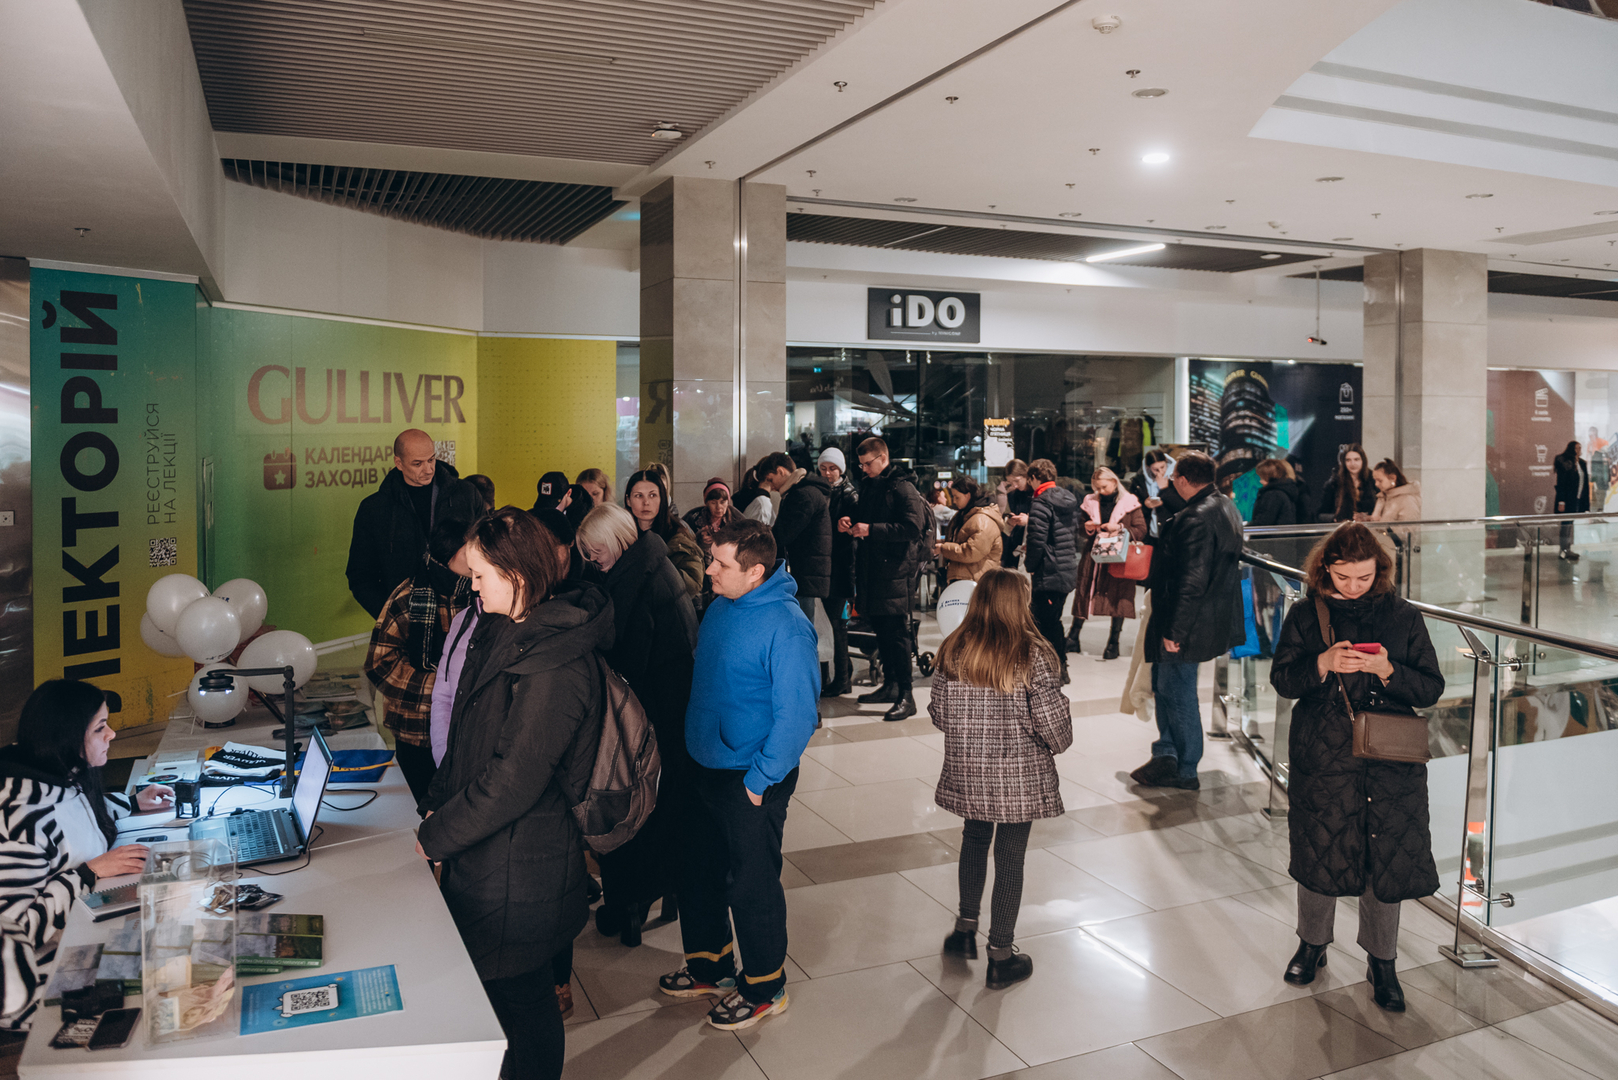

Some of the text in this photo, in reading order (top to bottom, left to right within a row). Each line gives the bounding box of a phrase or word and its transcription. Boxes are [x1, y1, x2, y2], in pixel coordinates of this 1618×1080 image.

[890, 293, 966, 329] iDO
[247, 364, 467, 425] GULLIVER
[144, 403, 161, 525] РЕЄСТРУЙСЯ
[160, 433, 178, 524] НА ЛЕКЦІЇ
[305, 445, 394, 466] КАЛЕНДАР
[305, 468, 379, 489] ЗАХОДІВ
